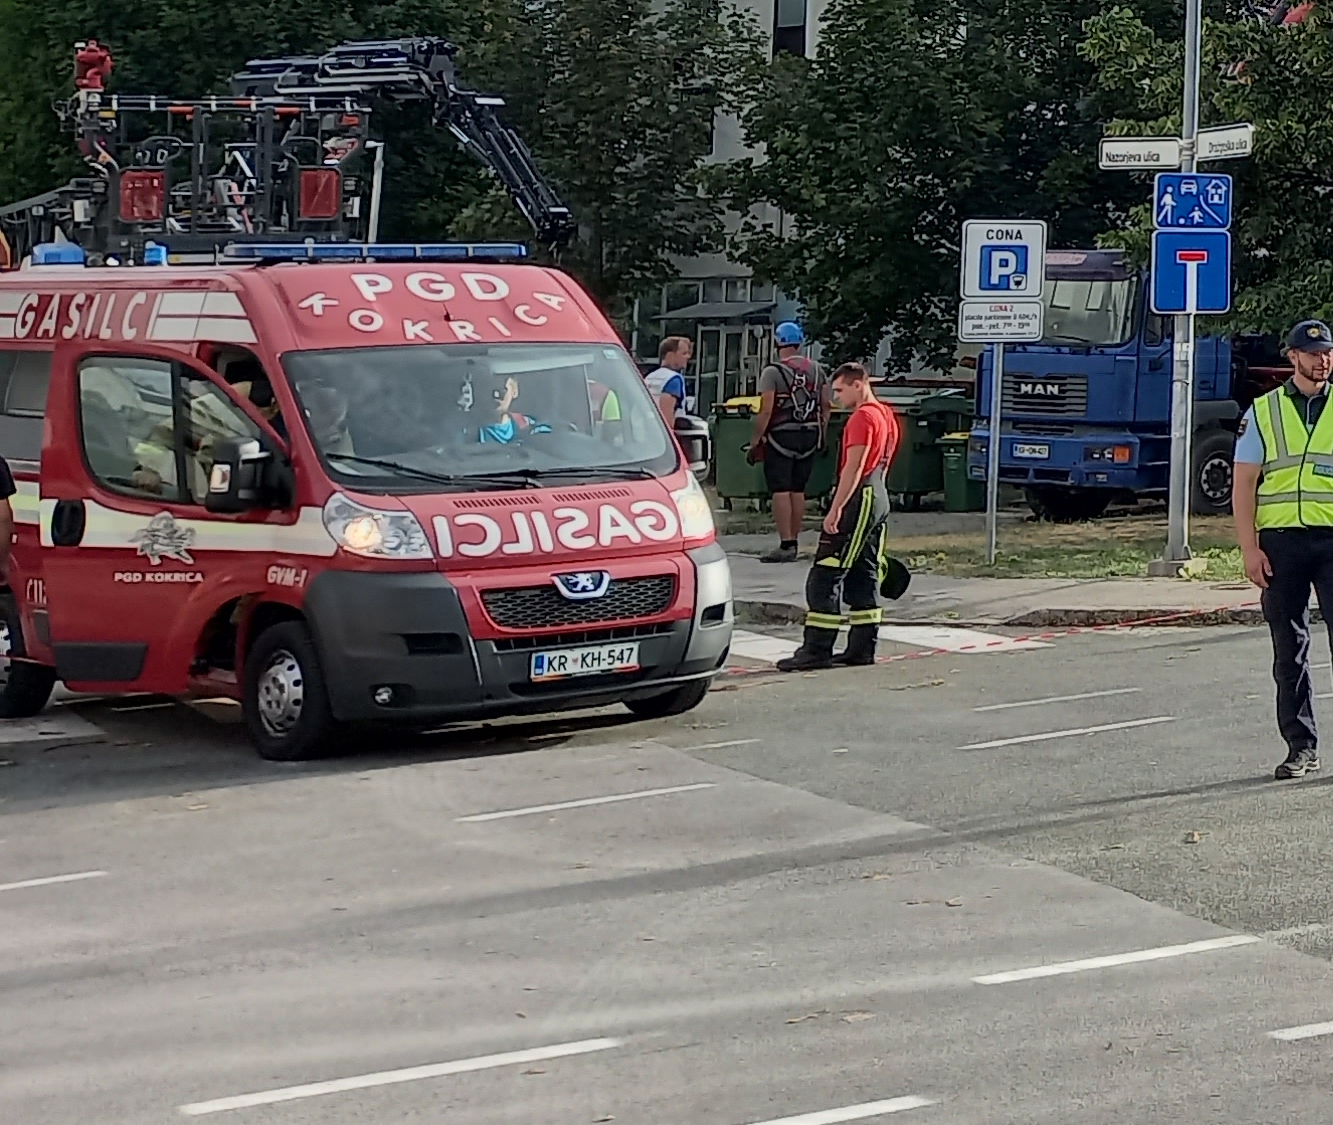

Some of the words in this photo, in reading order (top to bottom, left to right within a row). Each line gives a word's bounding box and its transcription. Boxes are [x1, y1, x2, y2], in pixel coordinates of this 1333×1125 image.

[1105, 151, 1142, 164] Nazorjeva
[1143, 150, 1161, 163] ulica
[986, 228, 1024, 241] CONA
[990, 251, 1017, 285] P
[351, 271, 510, 302] PGD
[14, 291, 165, 341] GASILCI
[298, 291, 566, 342] KOKRICA
[1020, 382, 1059, 396] MAN
[114, 572, 143, 583] PGD
[145, 571, 204, 583] KOKRICA
[546, 655, 568, 673] KR
[580, 647, 634, 670] KH-547
